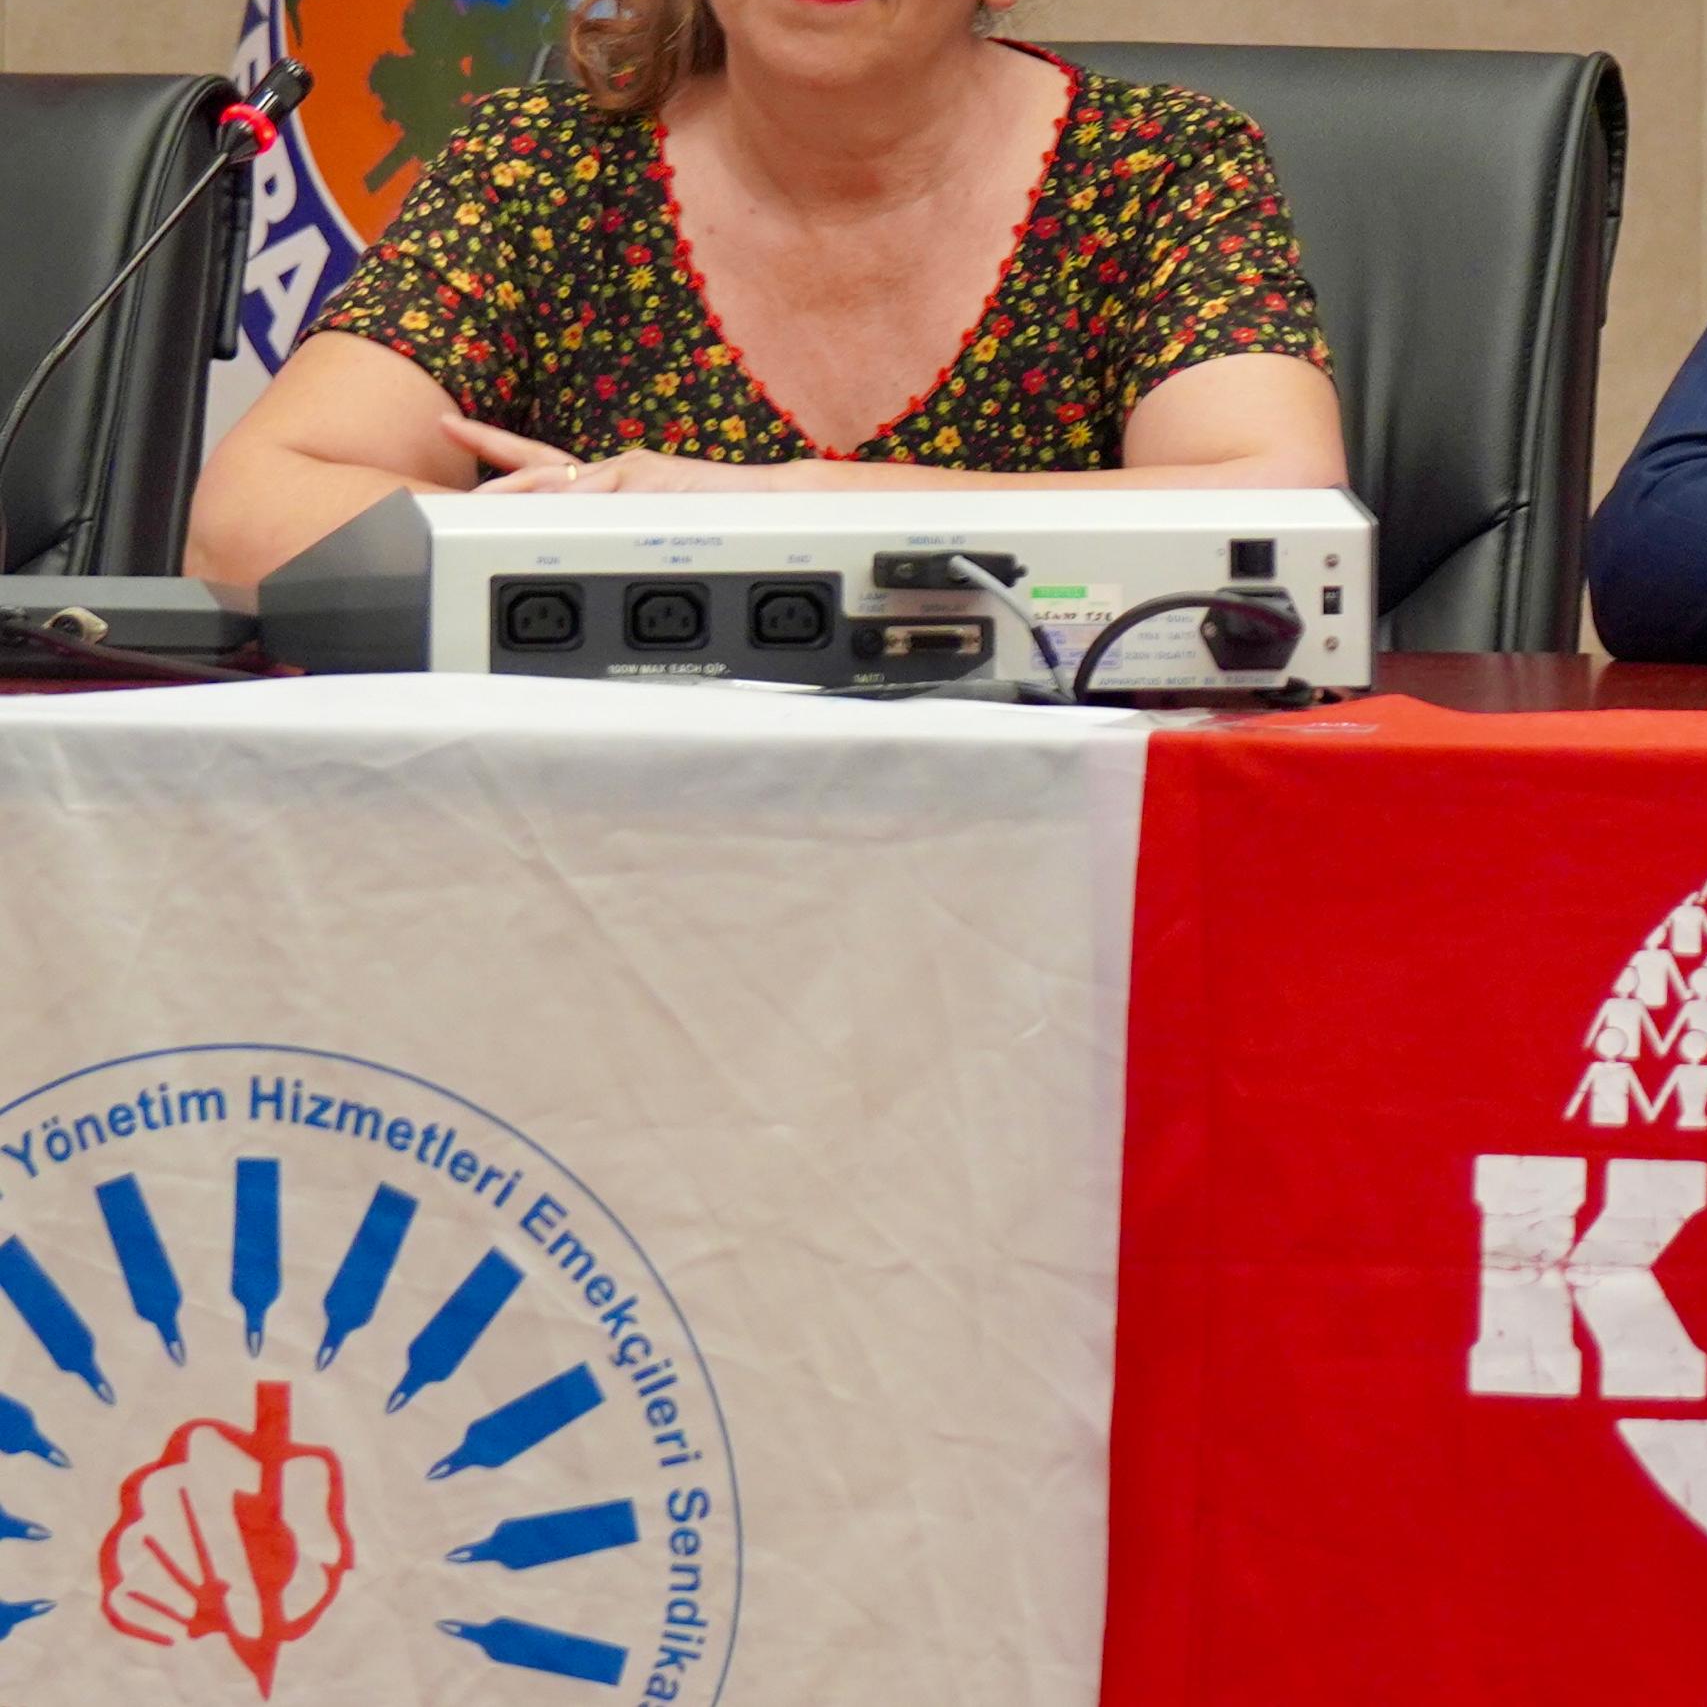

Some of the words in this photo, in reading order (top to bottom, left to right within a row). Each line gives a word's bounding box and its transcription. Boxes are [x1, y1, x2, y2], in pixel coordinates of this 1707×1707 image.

[0, 1083, 227, 1178] Yönetim
[249, 1075, 524, 1208] Hizmetleri
[518, 1191, 703, 1469] Emekçileri
[637, 1487, 711, 1707] Sendika
